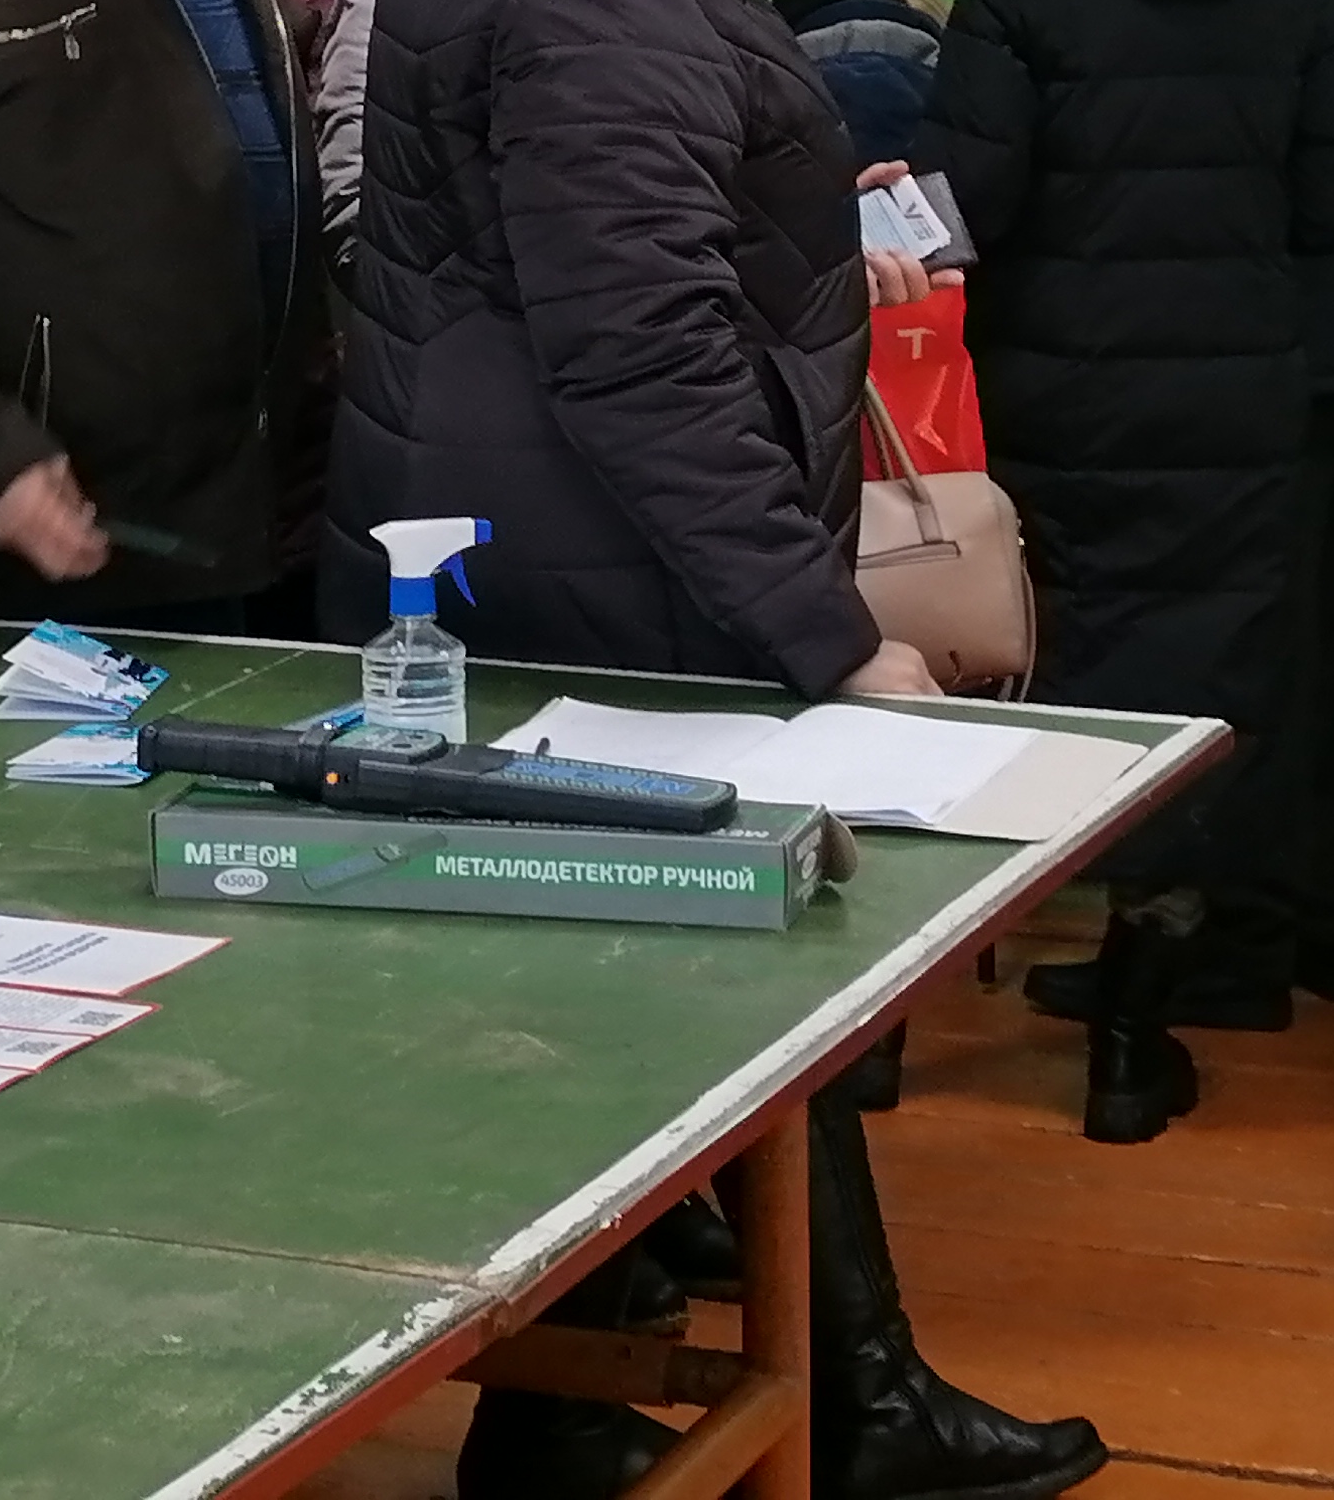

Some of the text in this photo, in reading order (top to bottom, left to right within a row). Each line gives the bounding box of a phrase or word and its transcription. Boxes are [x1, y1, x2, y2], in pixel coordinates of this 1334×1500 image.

[219, 873, 265, 889] 45003
[434, 854, 756, 892] МЕТАЛЛОДЕТЕКТОР РУЧНОЙ
